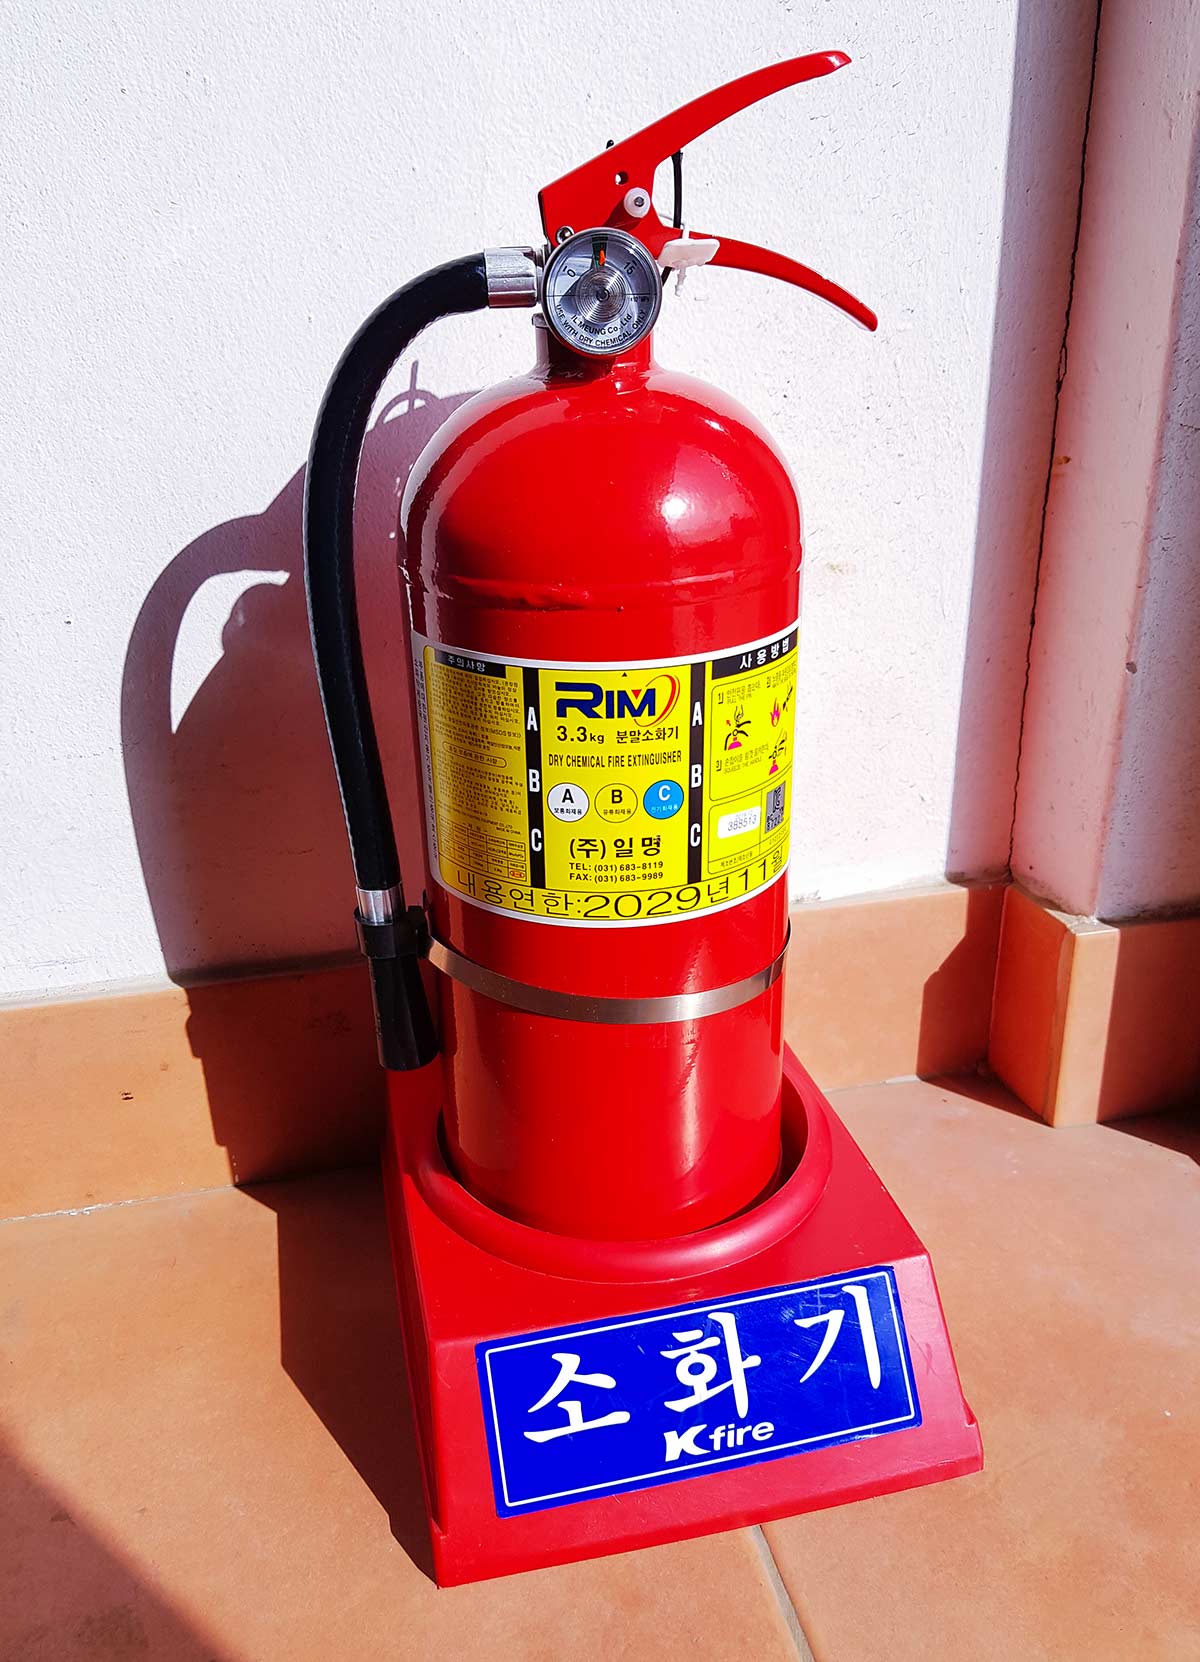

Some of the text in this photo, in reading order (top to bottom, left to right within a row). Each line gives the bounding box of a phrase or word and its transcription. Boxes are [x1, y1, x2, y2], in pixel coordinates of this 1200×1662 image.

[562, 266, 576, 277] 10
[623, 259, 638, 275] 15
[563, 319, 578, 338] WITH
[578, 334, 594, 344] DRY
[595, 330, 632, 347] CHEMICAL
[631, 310, 647, 330] ONLY
[447, 655, 486, 672] 주의사항
[739, 637, 790, 669] 사용방법
[555, 681, 656, 719] RIM
[526, 706, 538, 732] A
[691, 701, 703, 727] A
[556, 725, 679, 744] 3.3kg 분말소화기
[548, 750, 682, 768] DRY CHEMICAL FIRE EXTINGUISHER
[528, 768, 540, 793] B
[690, 763, 702, 788] B
[561, 788, 575, 804] A
[611, 789, 623, 804] B
[658, 785, 671, 801] C
[530, 828, 542, 852] C
[569, 834, 662, 859] (주) 일명
[690, 823, 702, 848] C
[569, 861, 664, 873] TEL: (031) 683-8119
[569, 871, 664, 884] FAX: (031) 683-9989
[523, 1284, 882, 1444] 소화기
